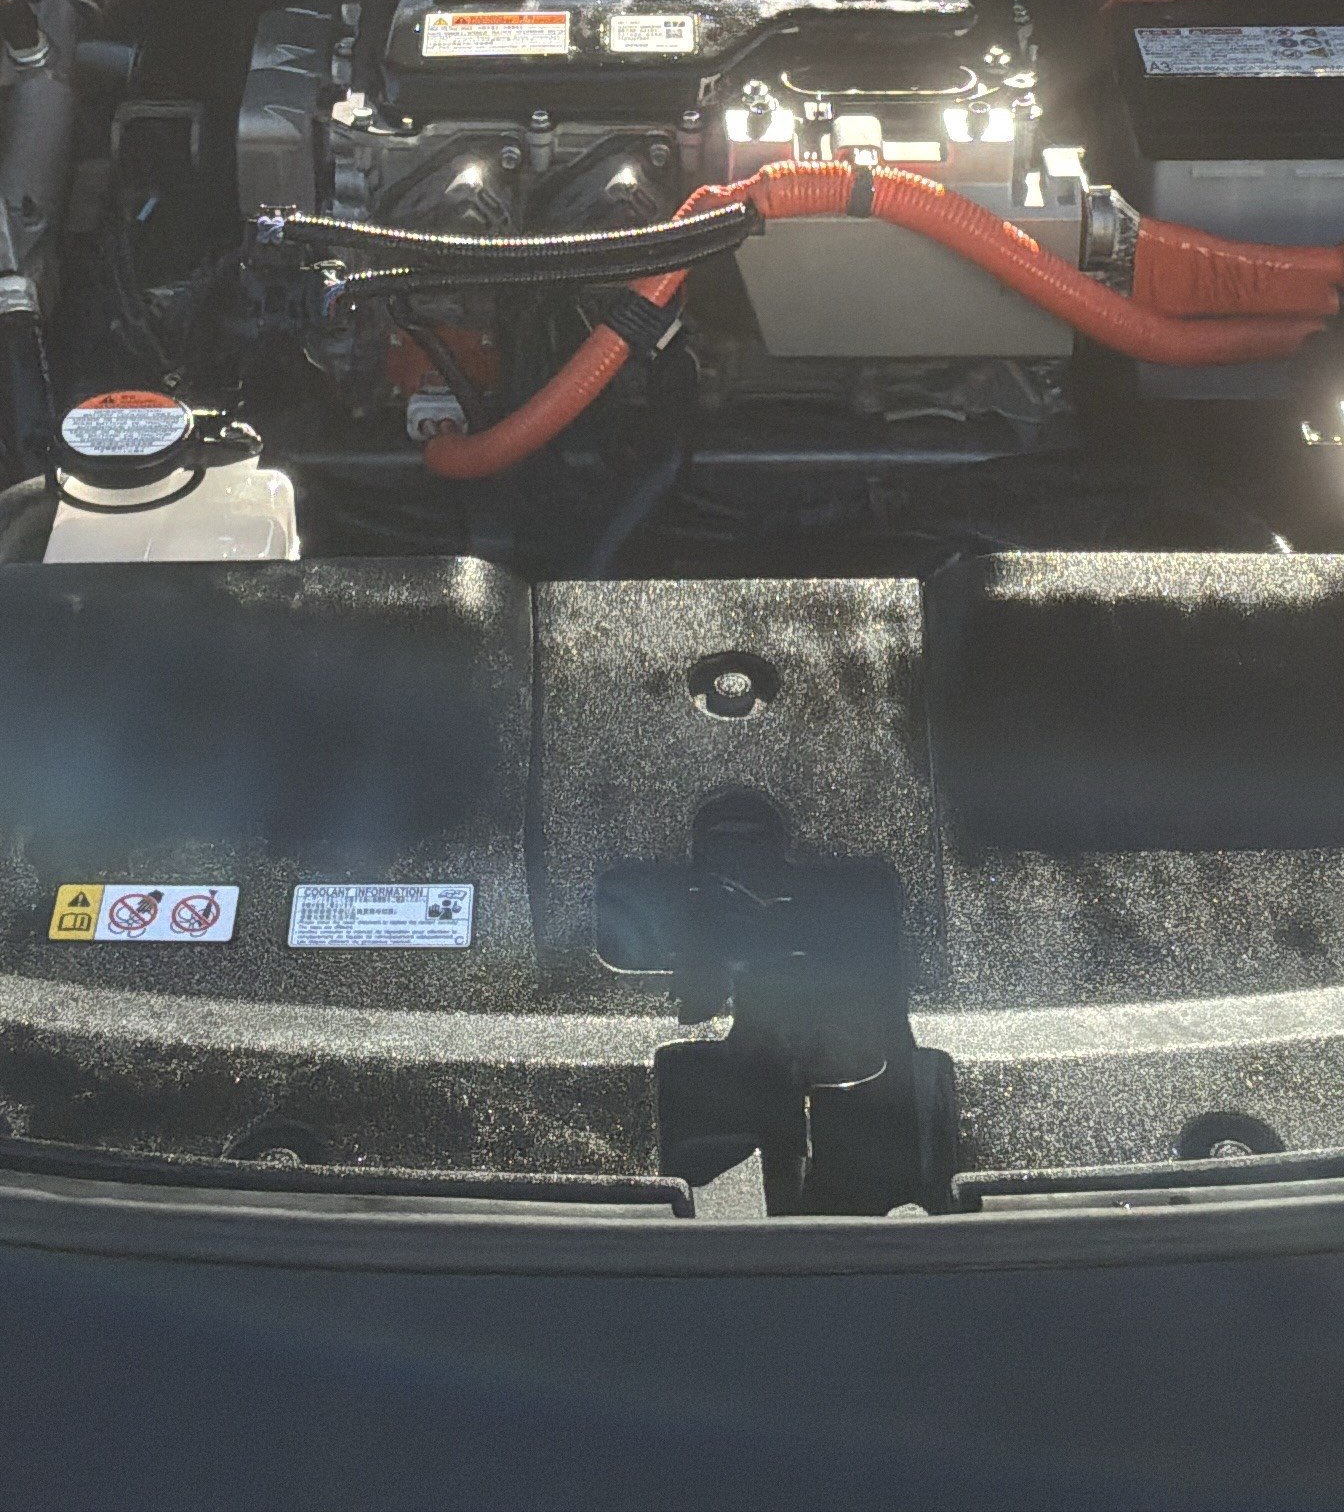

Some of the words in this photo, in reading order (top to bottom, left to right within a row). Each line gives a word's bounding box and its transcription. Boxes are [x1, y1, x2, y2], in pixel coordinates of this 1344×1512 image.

[1150, 61, 1171, 73] A3
[303, 887, 350, 897] COOLANT
[356, 887, 424, 897] INFORMATION
